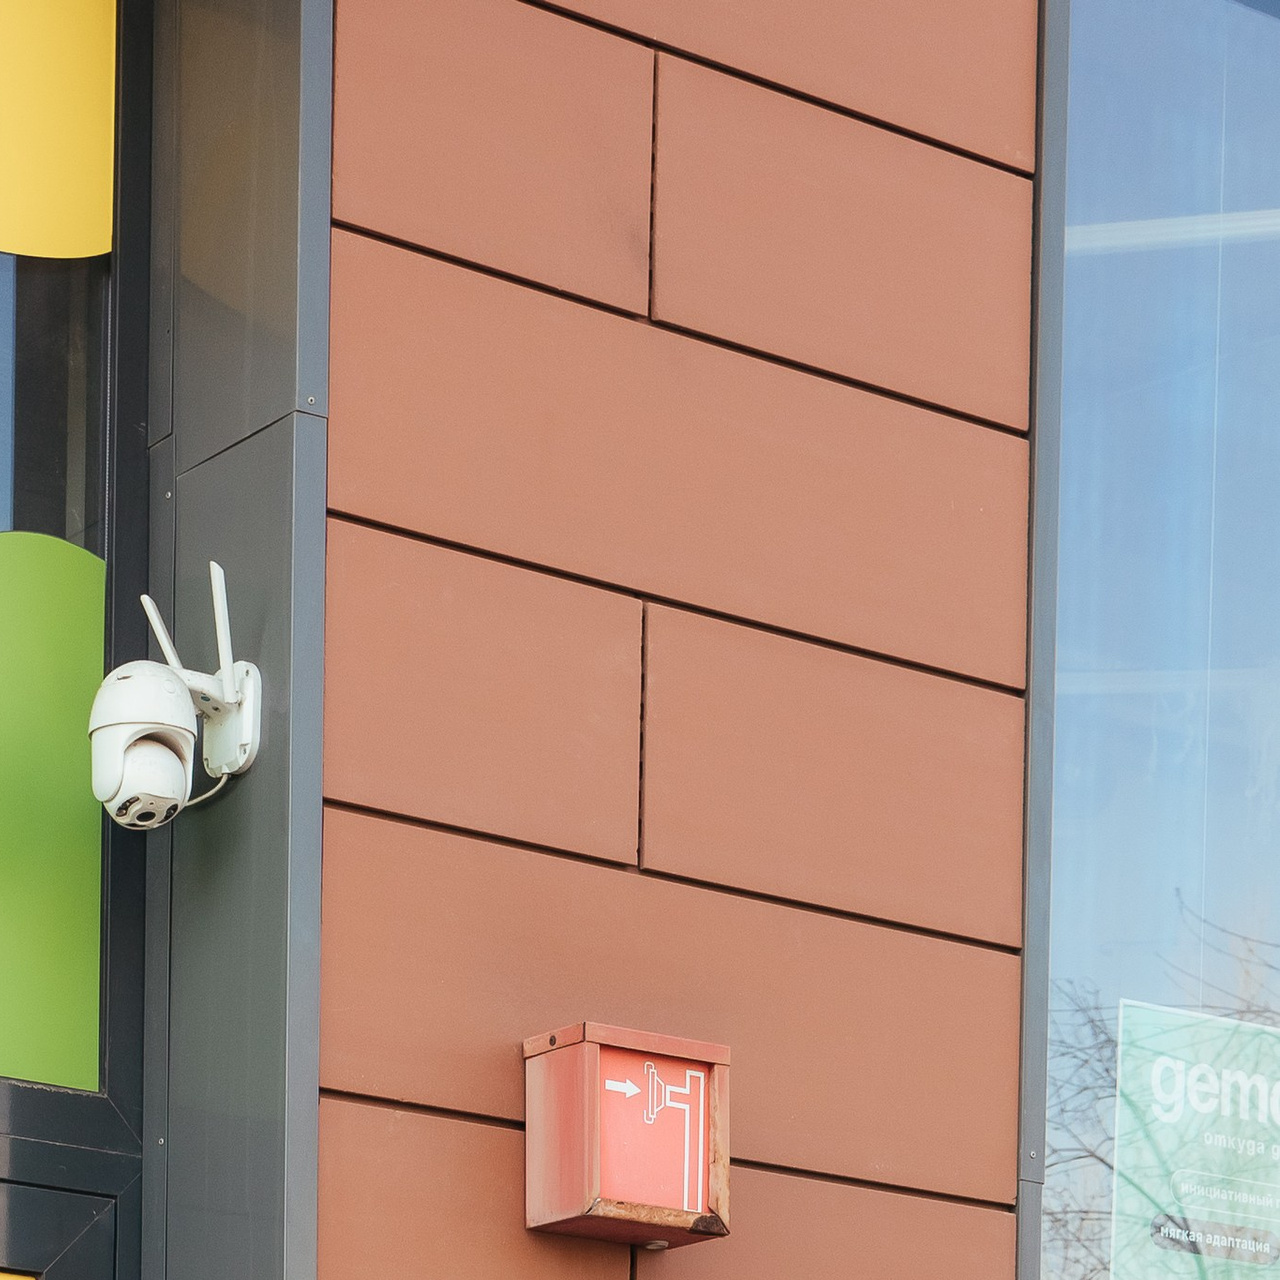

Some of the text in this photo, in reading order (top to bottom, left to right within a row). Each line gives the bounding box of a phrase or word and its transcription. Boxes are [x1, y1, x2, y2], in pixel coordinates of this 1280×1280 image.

[1180, 1183, 1273, 1208] инициативный
[1160, 1226, 1271, 1254] мягкая адаптация
